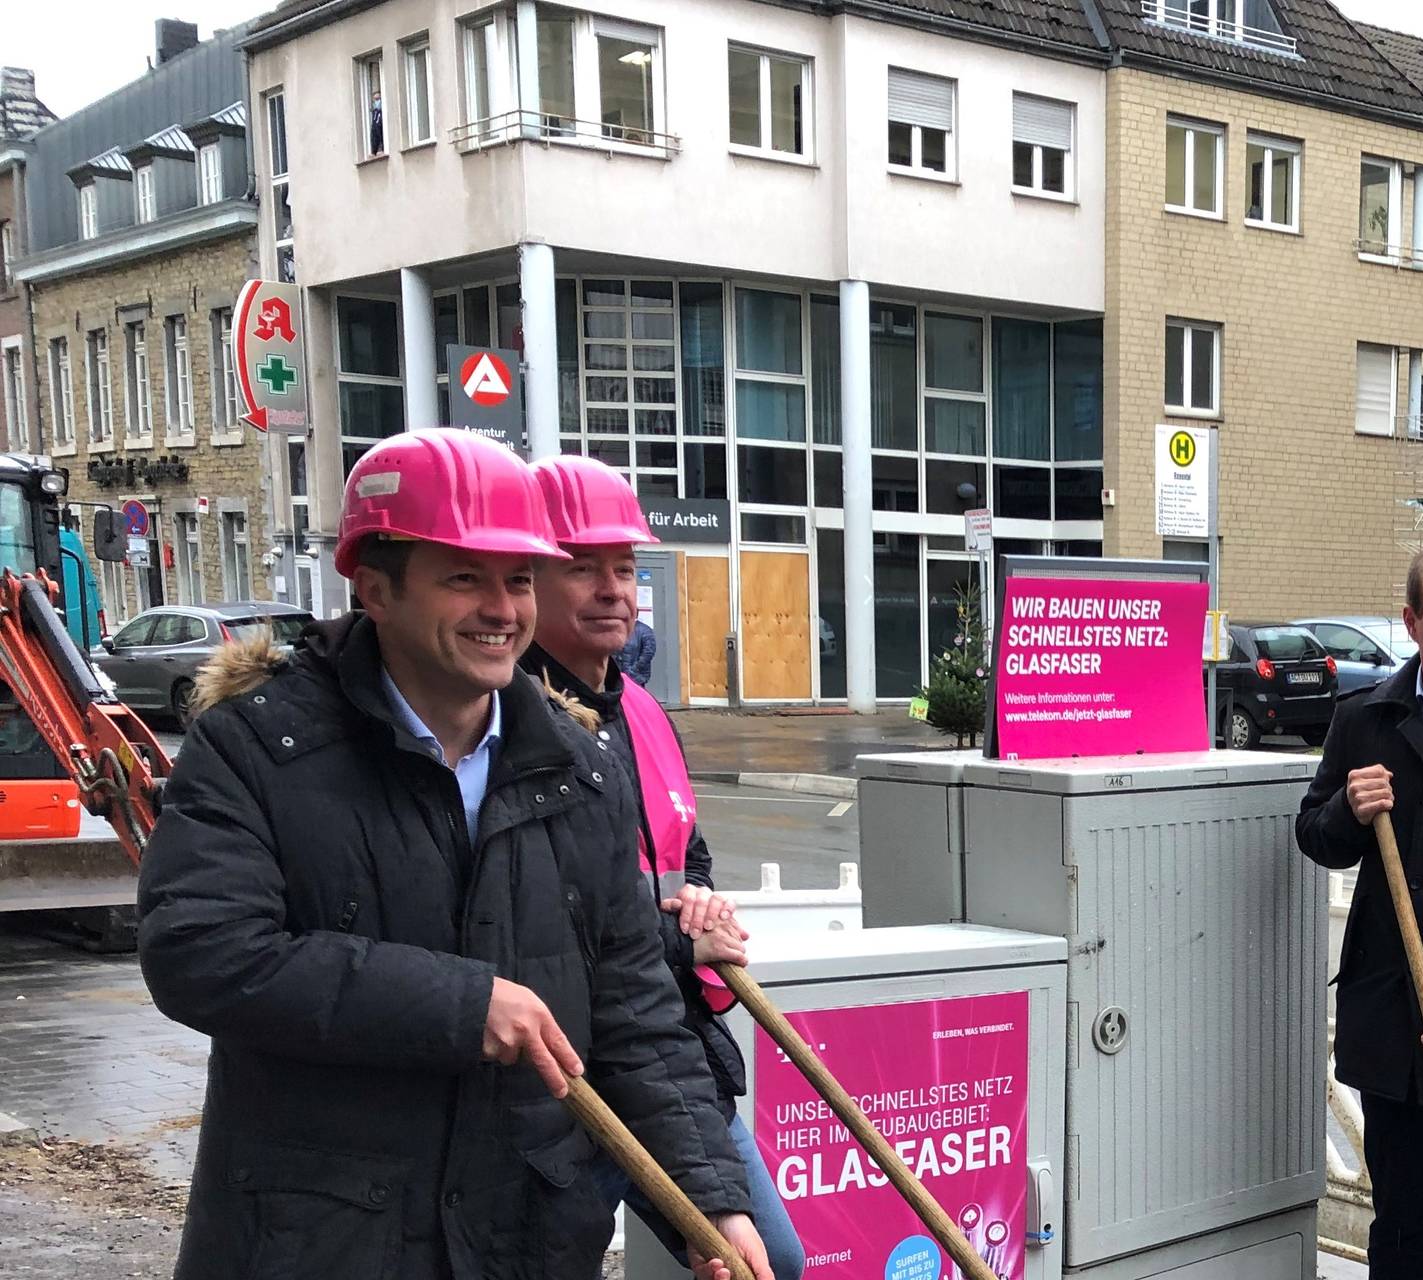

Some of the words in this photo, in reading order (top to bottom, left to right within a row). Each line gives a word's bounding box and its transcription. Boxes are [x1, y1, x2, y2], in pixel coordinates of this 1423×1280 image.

[1176, 438, 1189, 460] H
[648, 511, 670, 526] für
[673, 512, 719, 527] Arbeit
[1012, 597, 1045, 618] WIR
[1048, 598, 1105, 620] BAUEN
[1108, 599, 1161, 620] UNSER
[1008, 624, 1122, 647] SCHNELLSTES
[1124, 626, 1169, 647] NETZ:
[1005, 653, 1102, 675] GLASFASER
[1004, 693, 1037, 705] Weitere
[1038, 692, 1092, 703] Informationen
[1093, 692, 1116, 702] unter:
[1005, 708, 1132, 722] www.telekom.de/jetzt-glasfaser
[932, 1029, 965, 1040] ERLEBEN,
[964, 1026, 979, 1036] WAS
[979, 1022, 1015, 1034] VERBINDET.
[973, 1076, 1013, 1099] NETZ
[776, 1127, 821, 1151] HIER
[829, 1124, 850, 1144] IM
[871, 1104, 991, 1138] EUBAUGEBIET:
[806, 1249, 852, 1268] nternet
[895, 1249, 929, 1269] SURFEN
[908, 1263, 923, 1276] BIS
[923, 1258, 935, 1271] ZU
